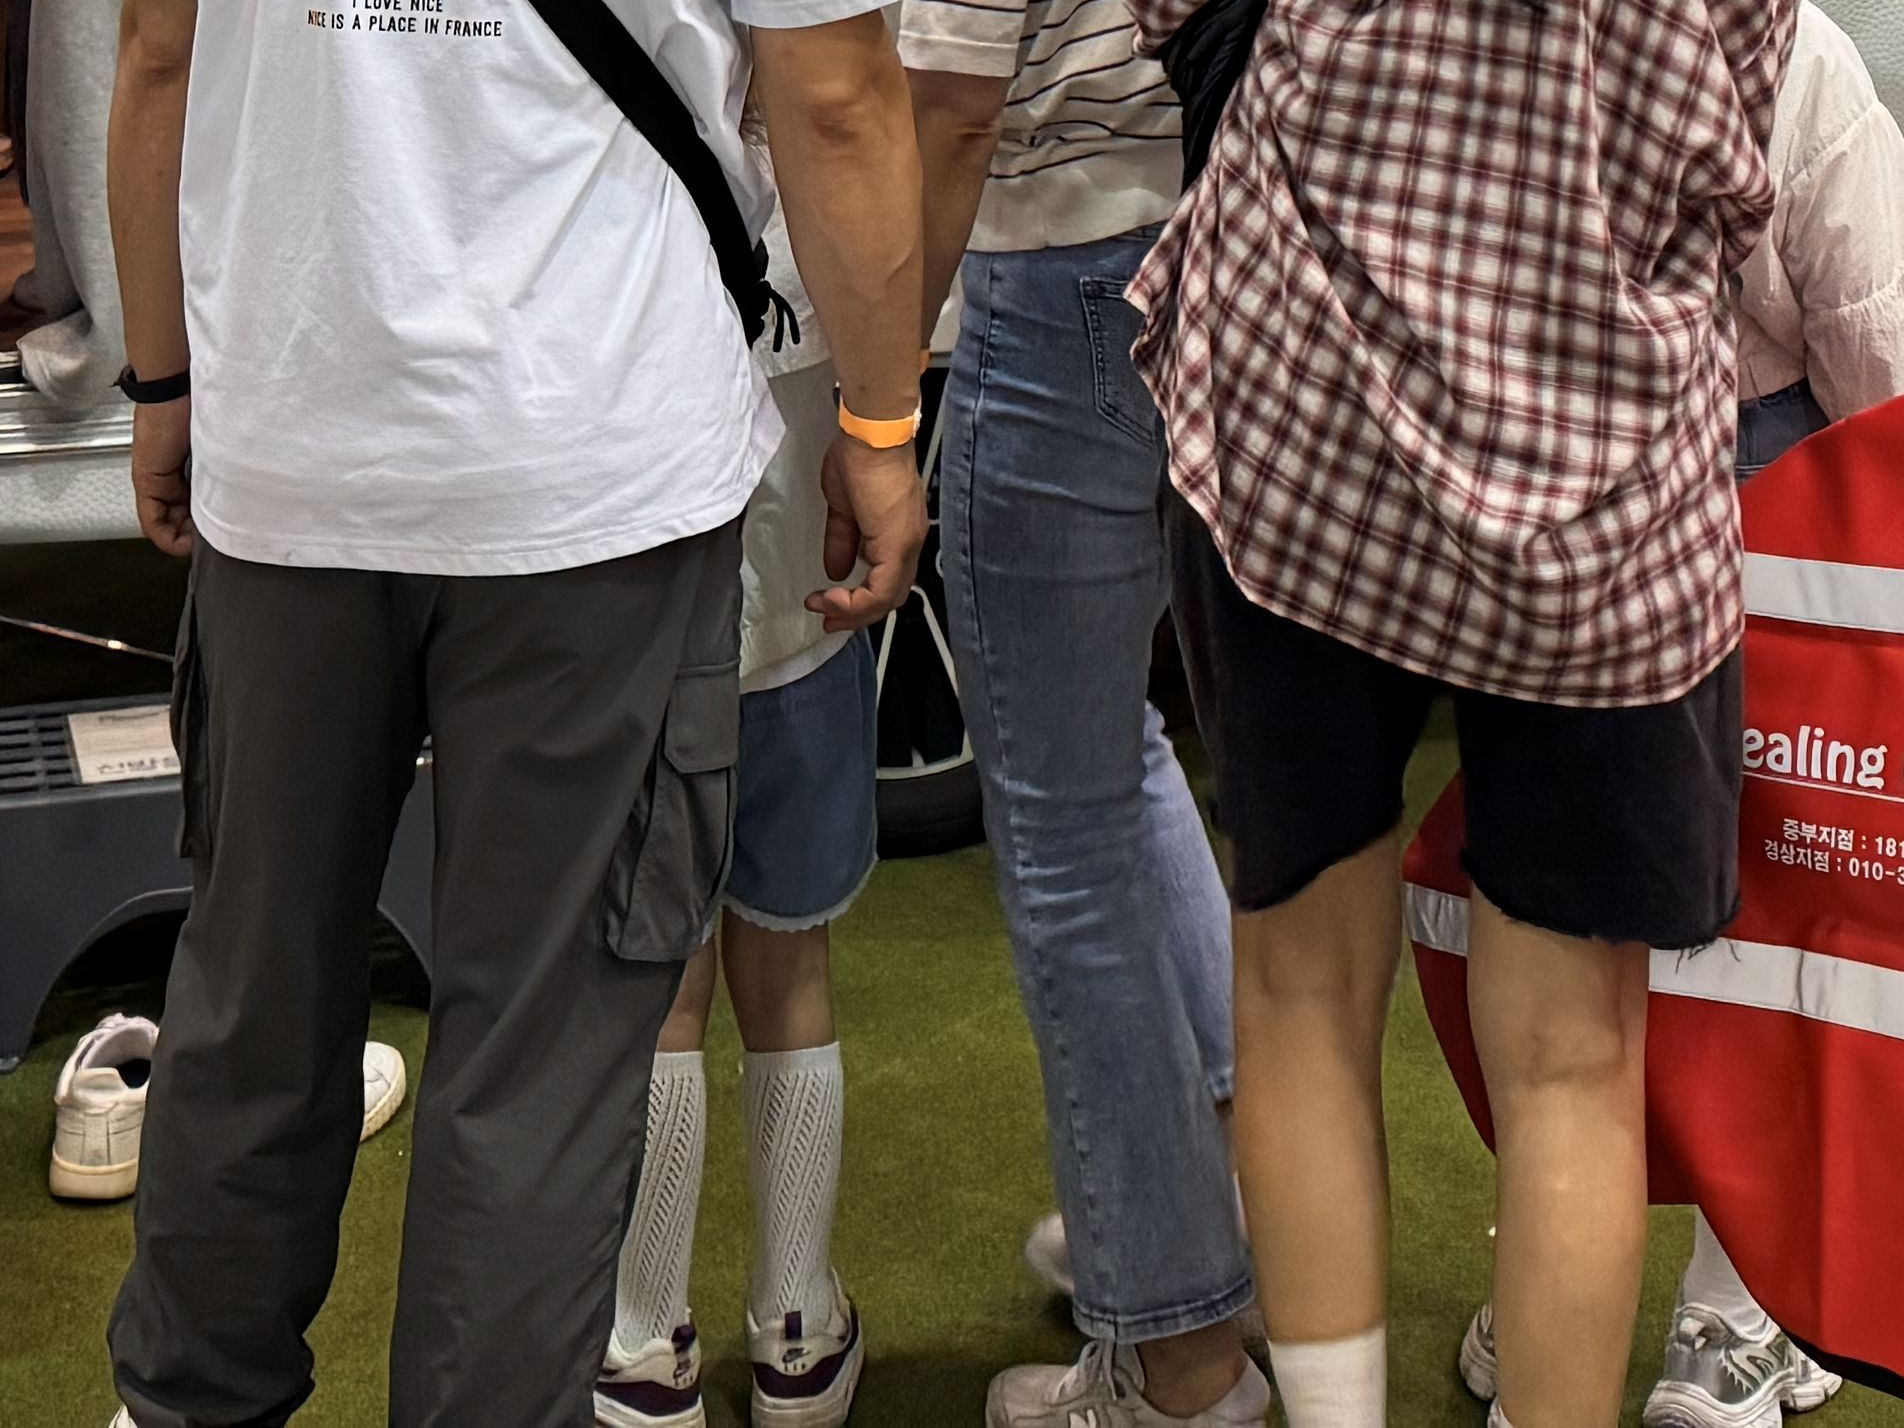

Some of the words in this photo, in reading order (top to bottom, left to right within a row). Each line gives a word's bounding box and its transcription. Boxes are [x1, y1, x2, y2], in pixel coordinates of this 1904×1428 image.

[307, 9, 326, 28] NICE
[331, 13, 344, 30] IS
[352, 14, 362, 31] A
[368, 15, 417, 33] PLACE
[424, 17, 440, 35] IN
[445, 19, 503, 37] FRANCE
[1782, 817, 1855, 851] 중부지점
[1763, 839, 1831, 874] 경상지점
